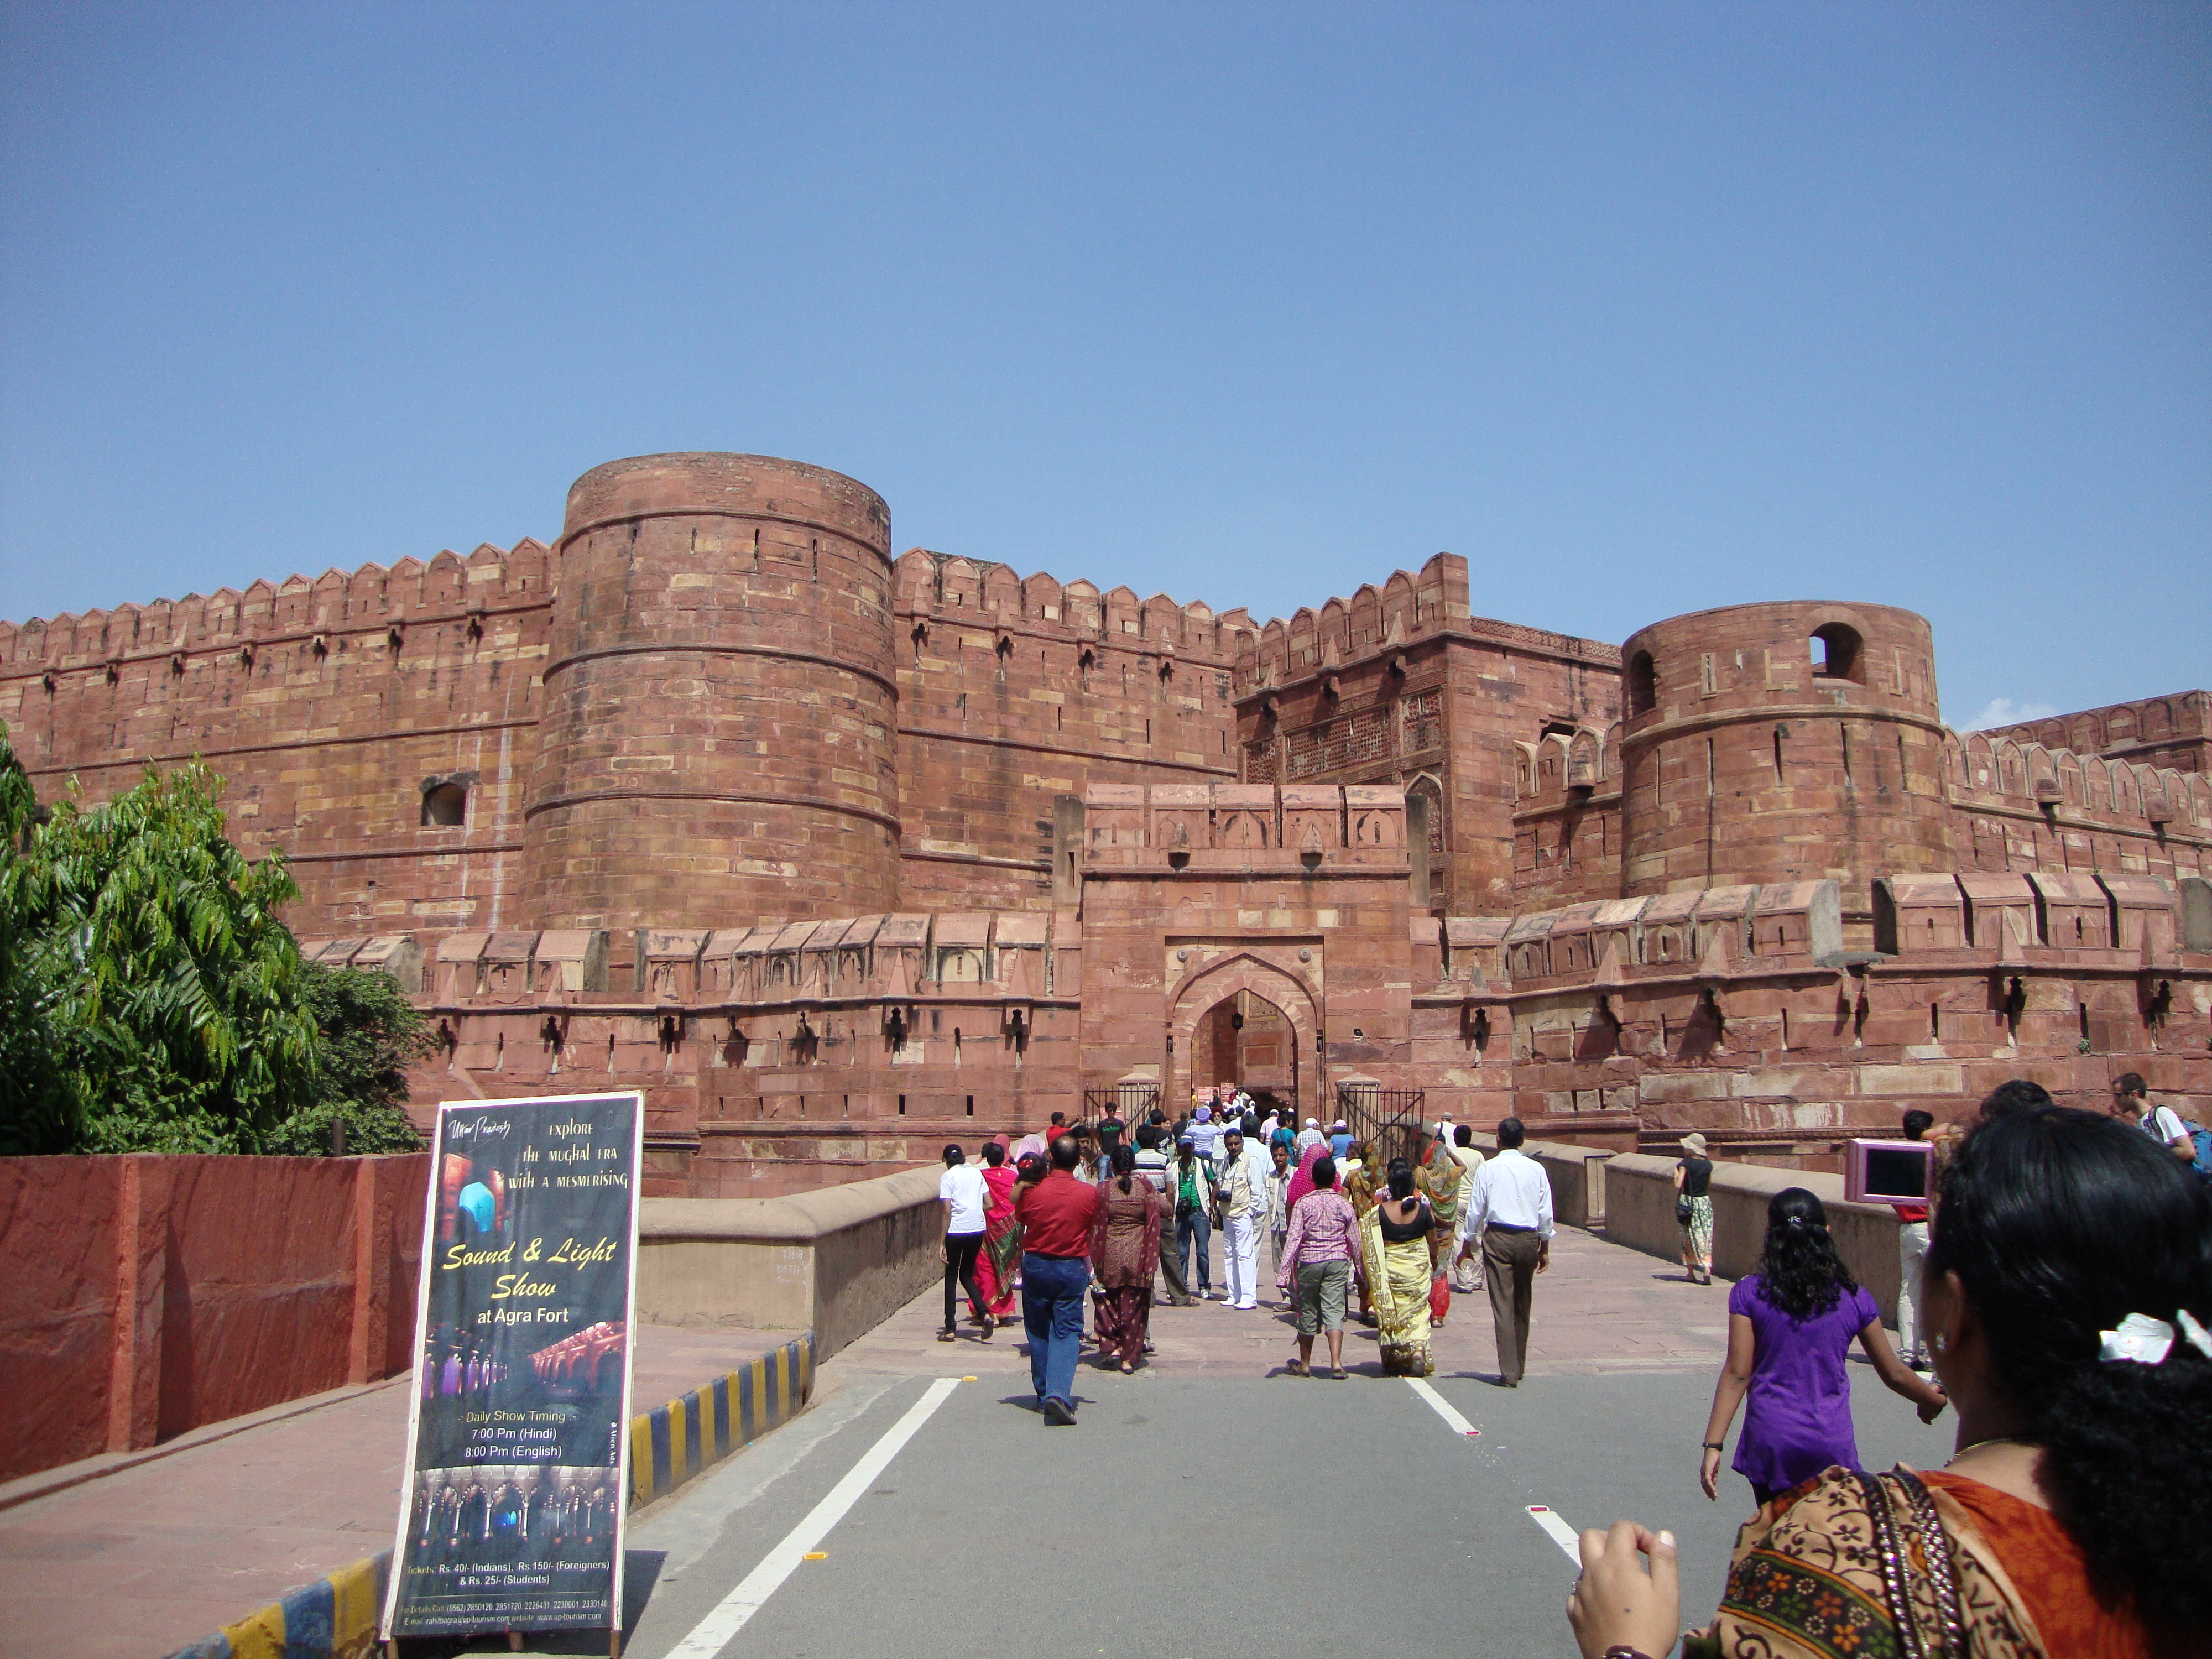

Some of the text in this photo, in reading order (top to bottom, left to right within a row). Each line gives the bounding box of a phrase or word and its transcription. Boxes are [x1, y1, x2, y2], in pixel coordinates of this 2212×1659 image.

[470, 1116, 511, 1142] Pradesh
[443, 1237, 618, 1271] Sound & Light
[491, 1272, 557, 1299] Show
[477, 1307, 569, 1326] at Agra Fort
[467, 1411, 491, 1423] Daily
[494, 1410, 525, 1421] Show
[529, 1410, 566, 1424] Timing
[472, 1428, 557, 1441] 7:00 Pm (Hindi)
[465, 1445, 562, 1459] 8:00 Pm (English)
[439, 1564, 451, 1573] Rs.
[454, 1563, 469, 1572] 40/-
[556, 1561, 609, 1573] (Foreigners)
[460, 1574, 550, 1586] & Rs. 25/- (Students)
[447, 1603, 466, 1613] (0562)
